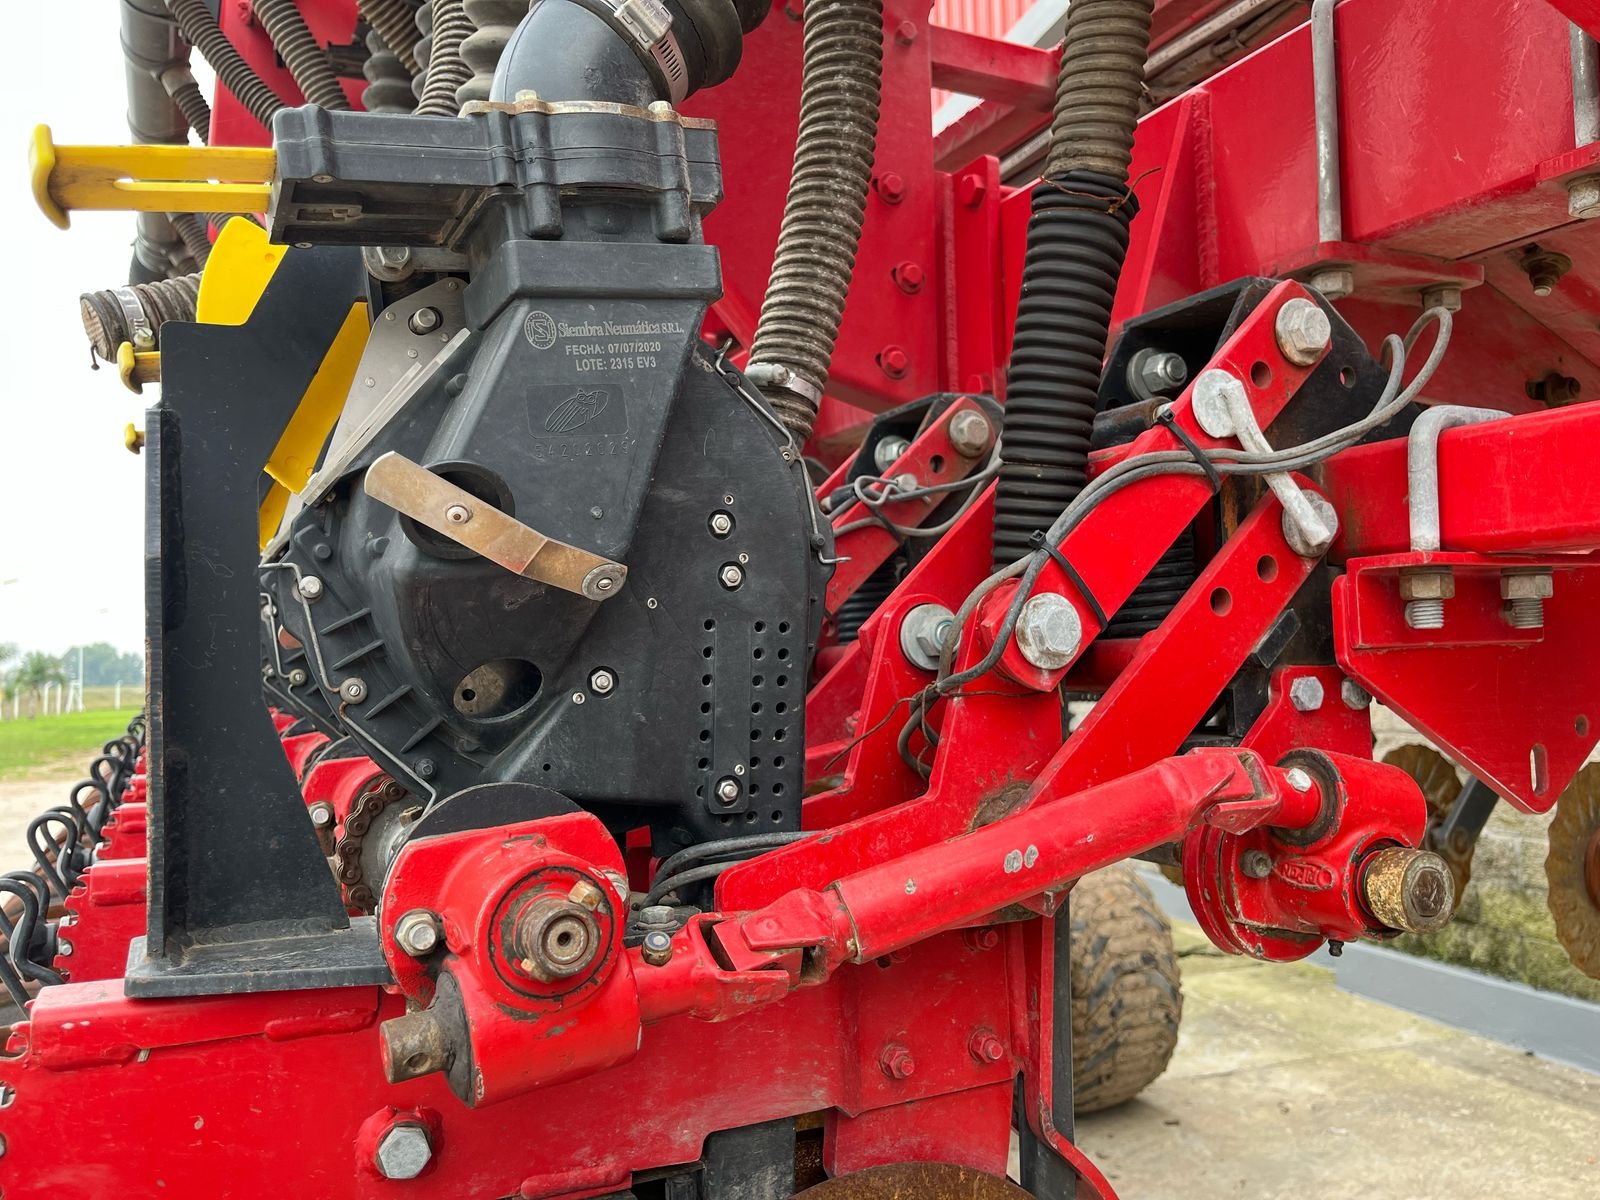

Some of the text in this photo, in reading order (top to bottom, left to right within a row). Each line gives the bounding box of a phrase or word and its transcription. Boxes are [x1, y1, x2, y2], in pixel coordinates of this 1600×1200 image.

[558, 321, 604, 338] Siembra
[603, 320, 661, 336] Neumática
[565, 341, 661, 355] FECHA: 07/07/2020
[575, 356, 657, 372] LOTE: 2315 EV3
